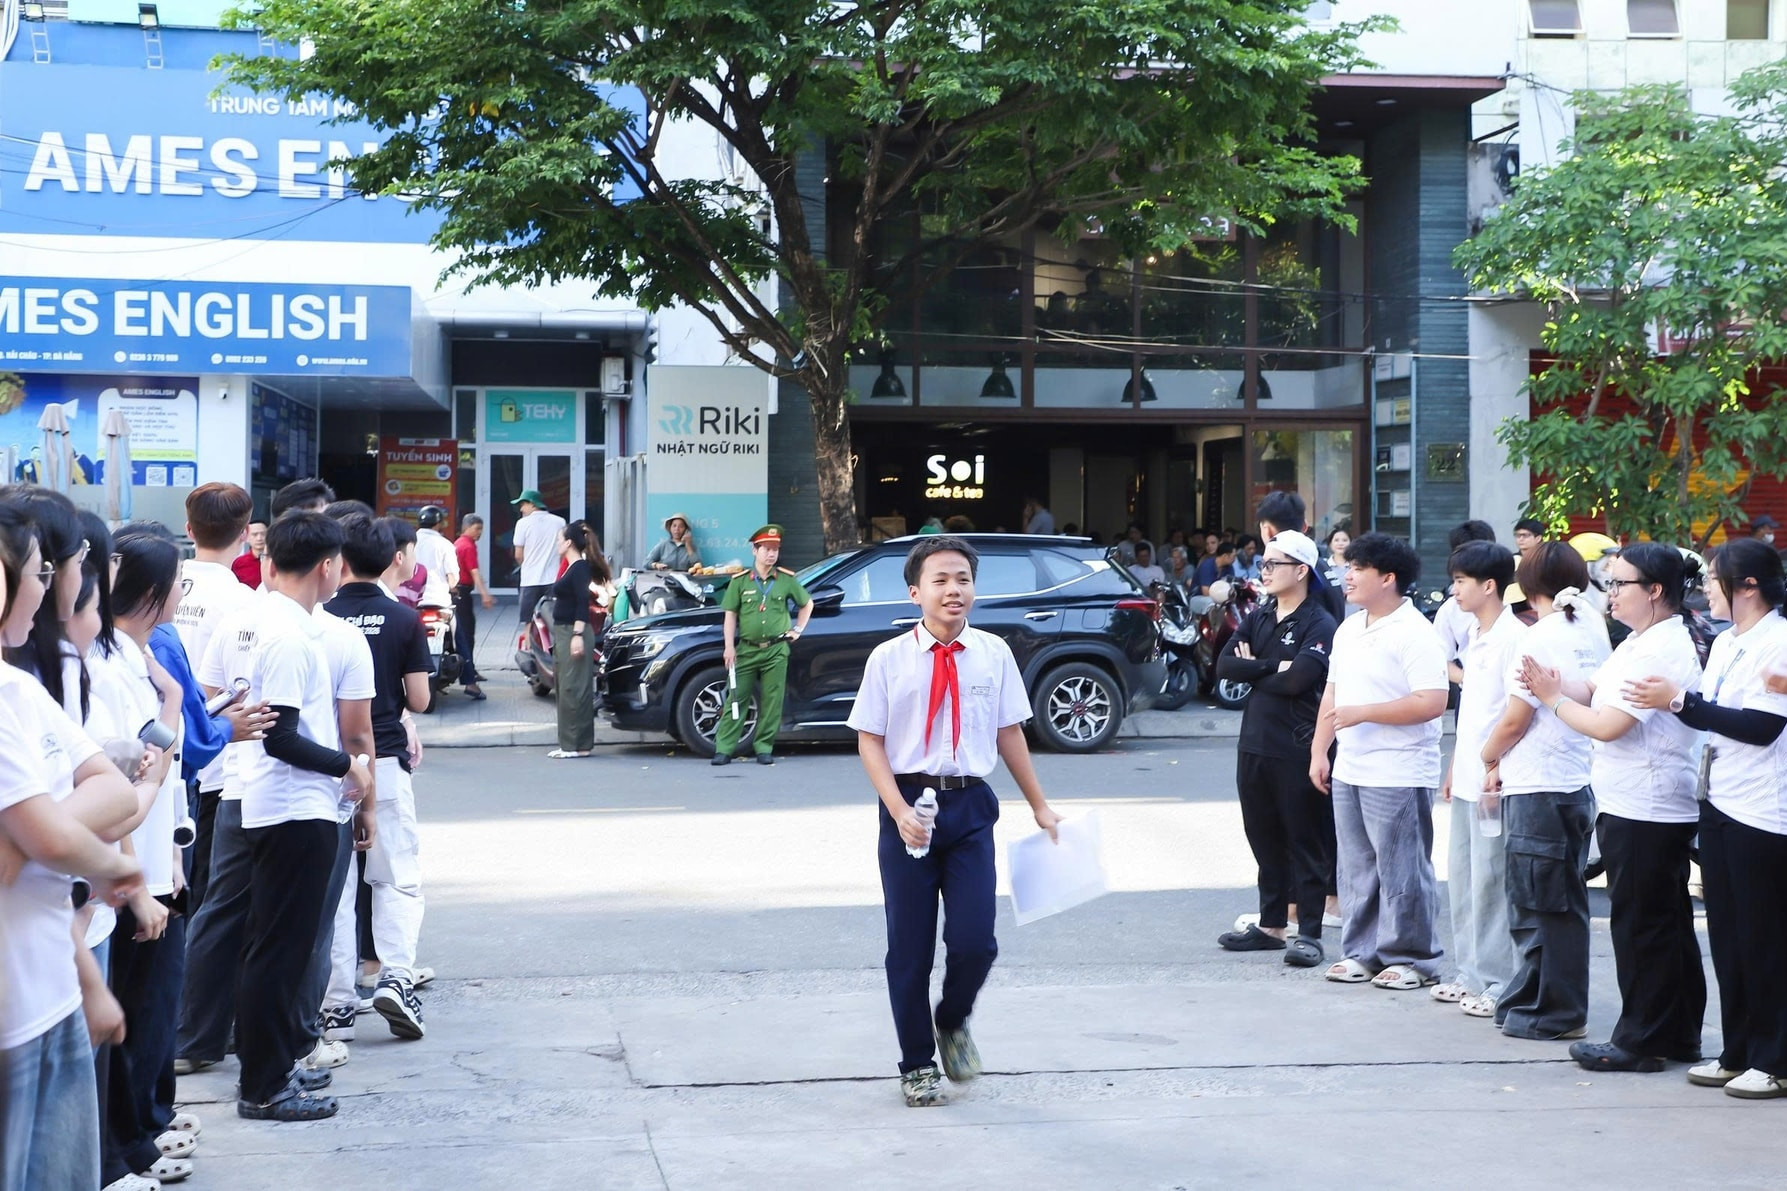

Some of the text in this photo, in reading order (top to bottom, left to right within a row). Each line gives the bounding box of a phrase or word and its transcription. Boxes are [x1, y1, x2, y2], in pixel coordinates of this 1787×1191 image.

[209, 96, 281, 116] TRUNG
[24, 131, 259, 199] AMES
[114, 290, 368, 341] ENGLISH
[144, 388, 176, 396] ENGLISH
[700, 406, 760, 435] Riki
[425, 453, 452, 463] SINH
[657, 440, 760, 457] NHẬT NGỮ RIKI
[926, 454, 985, 485] Soi
[925, 484, 952, 498] cafe
[963, 486, 984, 499] tea
